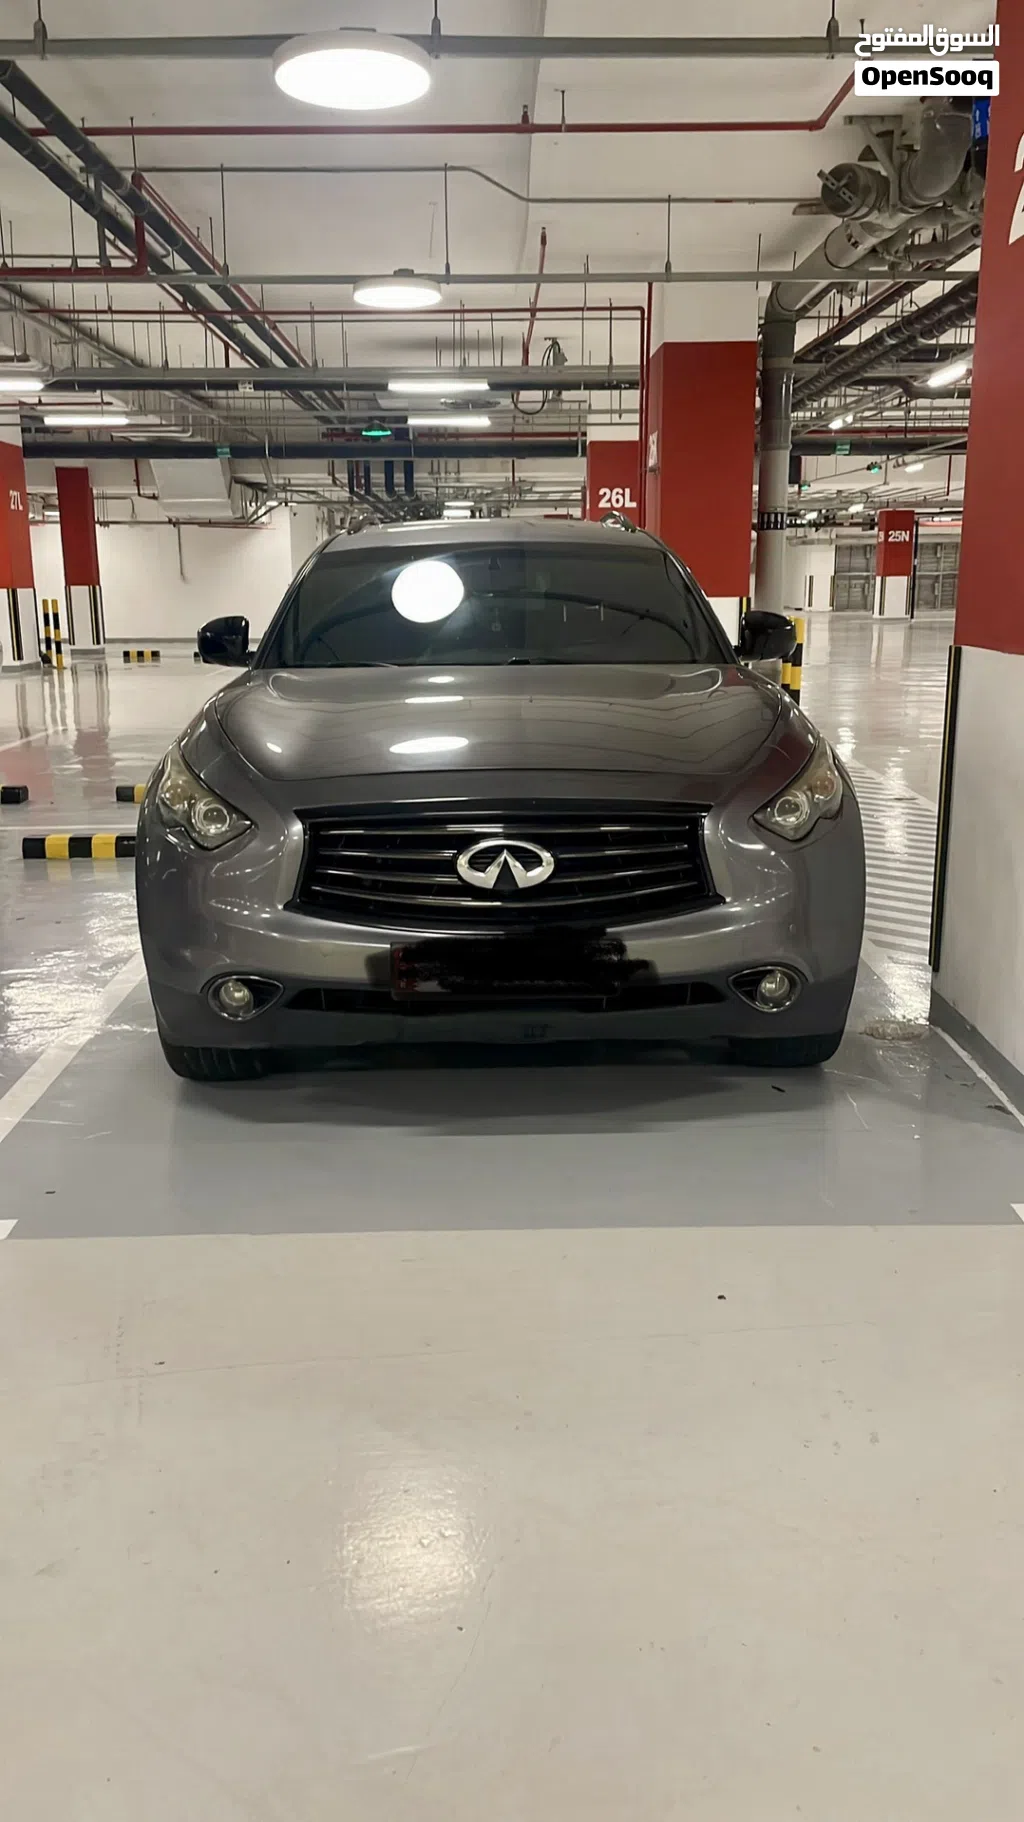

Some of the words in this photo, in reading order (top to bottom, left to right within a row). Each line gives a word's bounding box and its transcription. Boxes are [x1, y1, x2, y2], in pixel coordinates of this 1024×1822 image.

[9, 489, 24, 511] 27L
[598, 487, 637, 508] 26L
[887, 530, 910, 542] 25N
